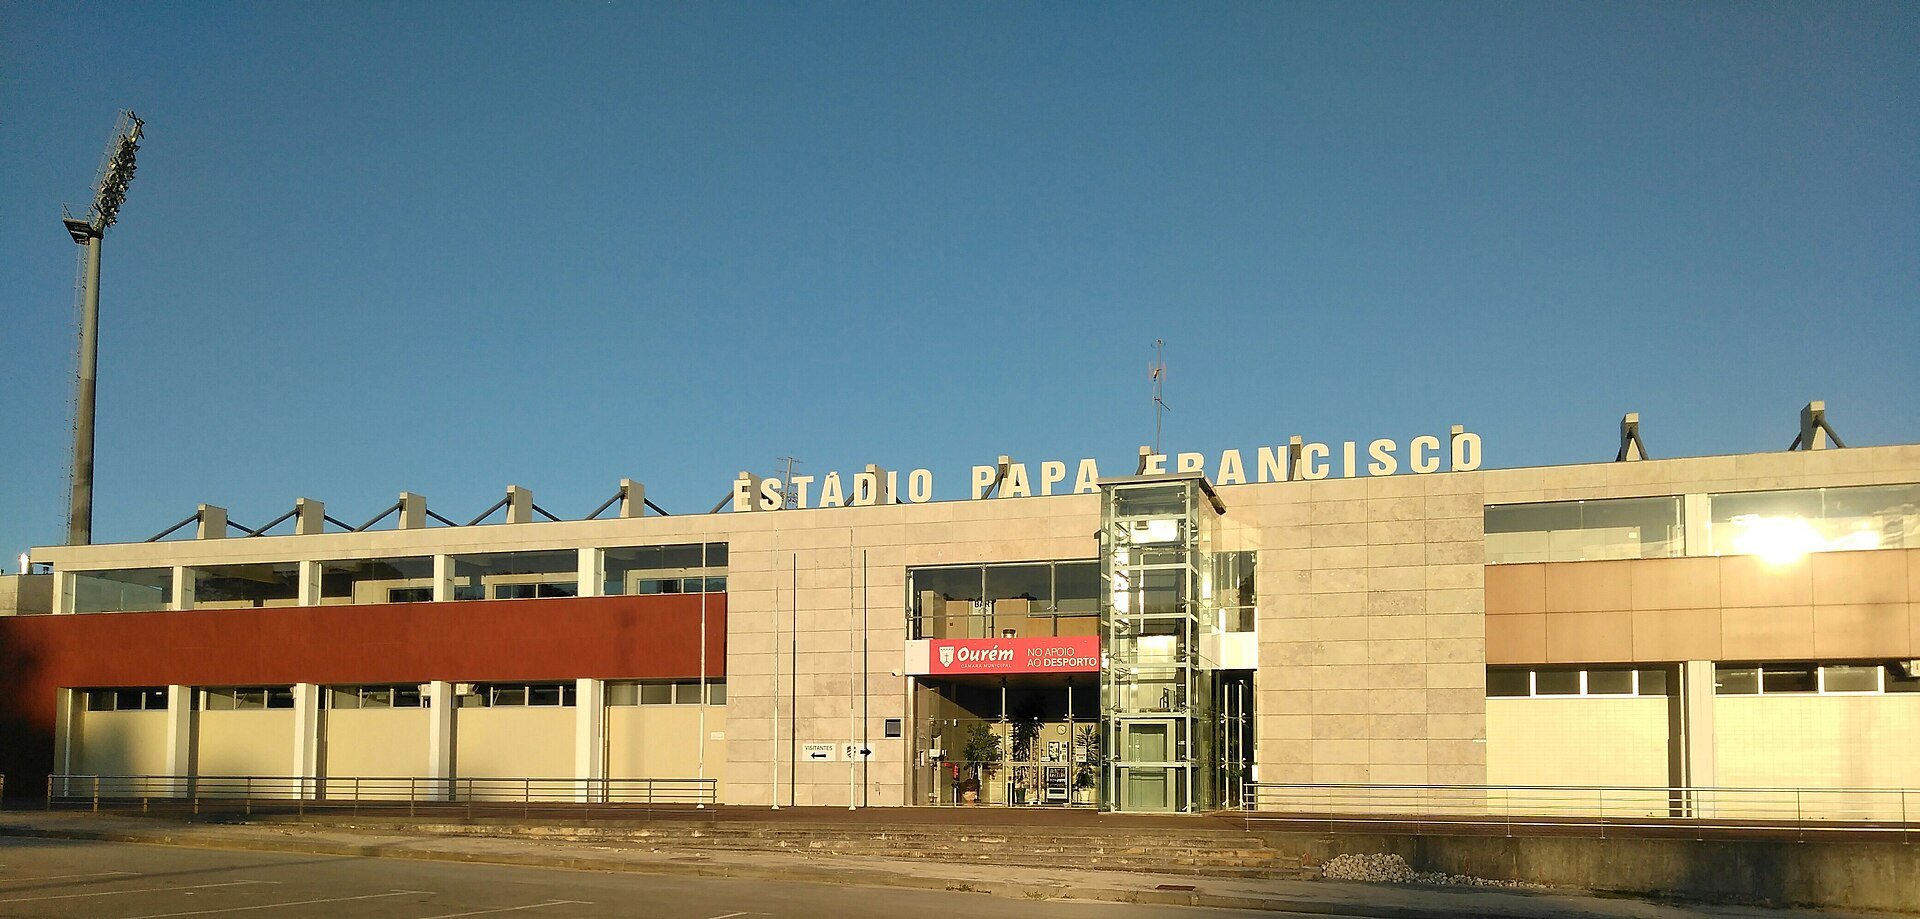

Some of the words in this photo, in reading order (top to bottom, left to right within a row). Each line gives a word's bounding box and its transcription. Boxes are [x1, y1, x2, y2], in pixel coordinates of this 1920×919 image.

[733, 468, 933, 512] ESTÁDIO
[972, 458, 1102, 500] PAPA
[1145, 432, 1482, 486] FRANCISCO
[957, 645, 1014, 662] Ourém
[1027, 648, 1042, 657] NO
[1044, 647, 1075, 657] APOIO
[1027, 658, 1042, 667] AO
[1043, 657, 1097, 667] DESPORTO
